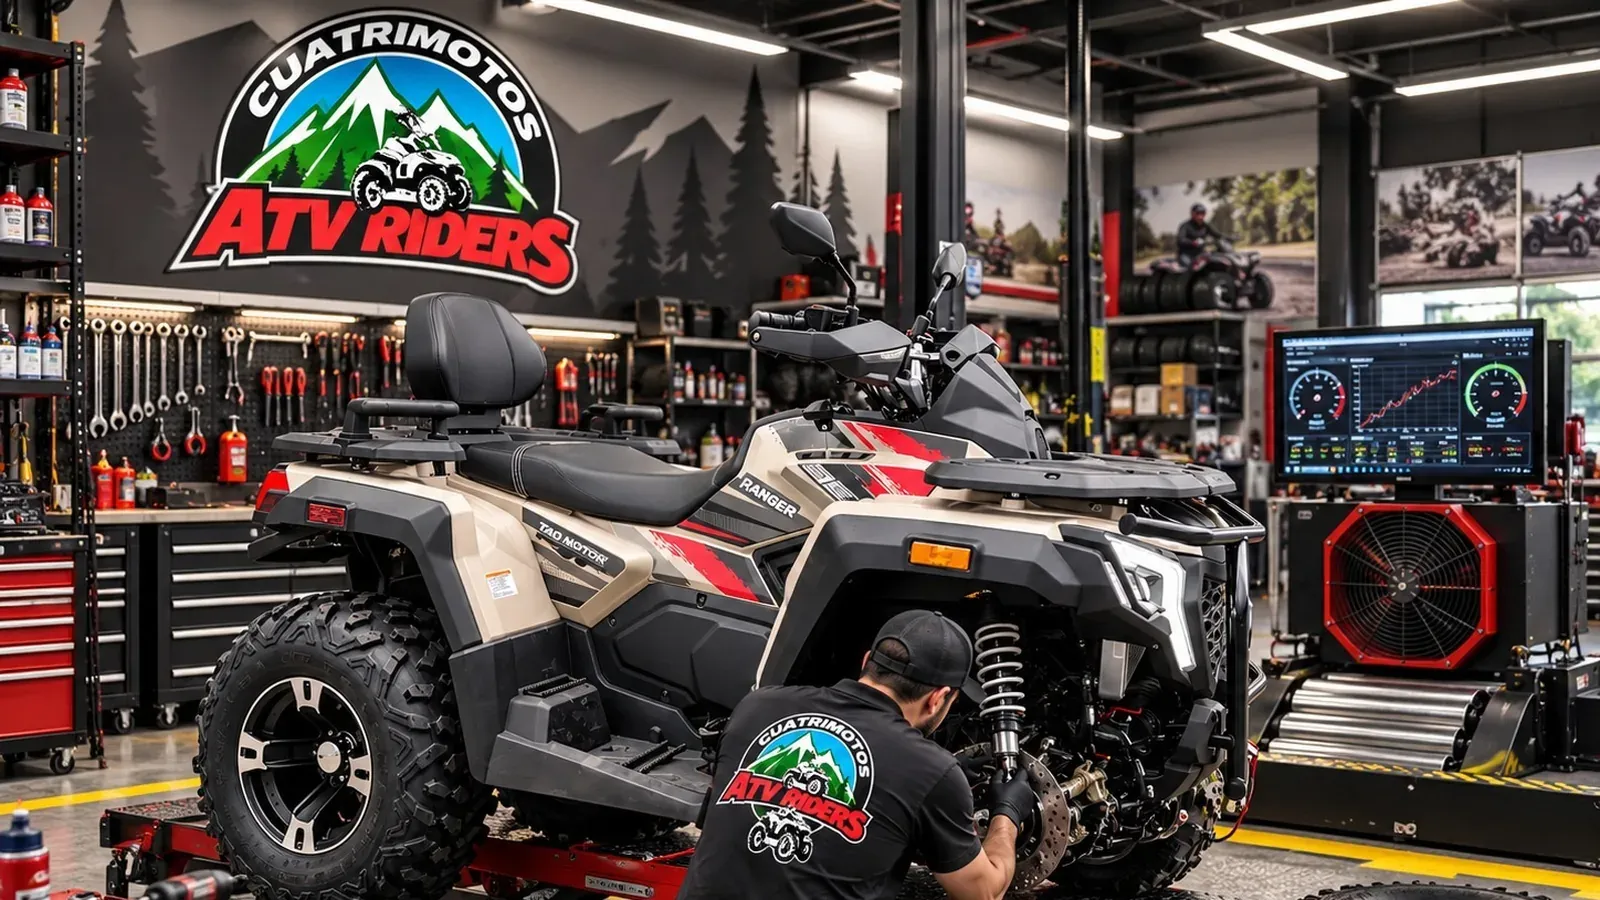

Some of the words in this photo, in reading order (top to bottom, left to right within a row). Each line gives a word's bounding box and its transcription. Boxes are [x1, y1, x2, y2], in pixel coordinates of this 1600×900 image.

[248, 21, 543, 143] CUATRIMOTOS
[192, 187, 365, 257] ATV
[360, 204, 572, 285] RIDERS
[739, 477, 798, 519] RANGER
[562, 535, 609, 566] MOTOR
[758, 716, 870, 778] CUATRIMOTOS
[722, 770, 783, 802] ATV
[779, 788, 868, 841] RIDERS
